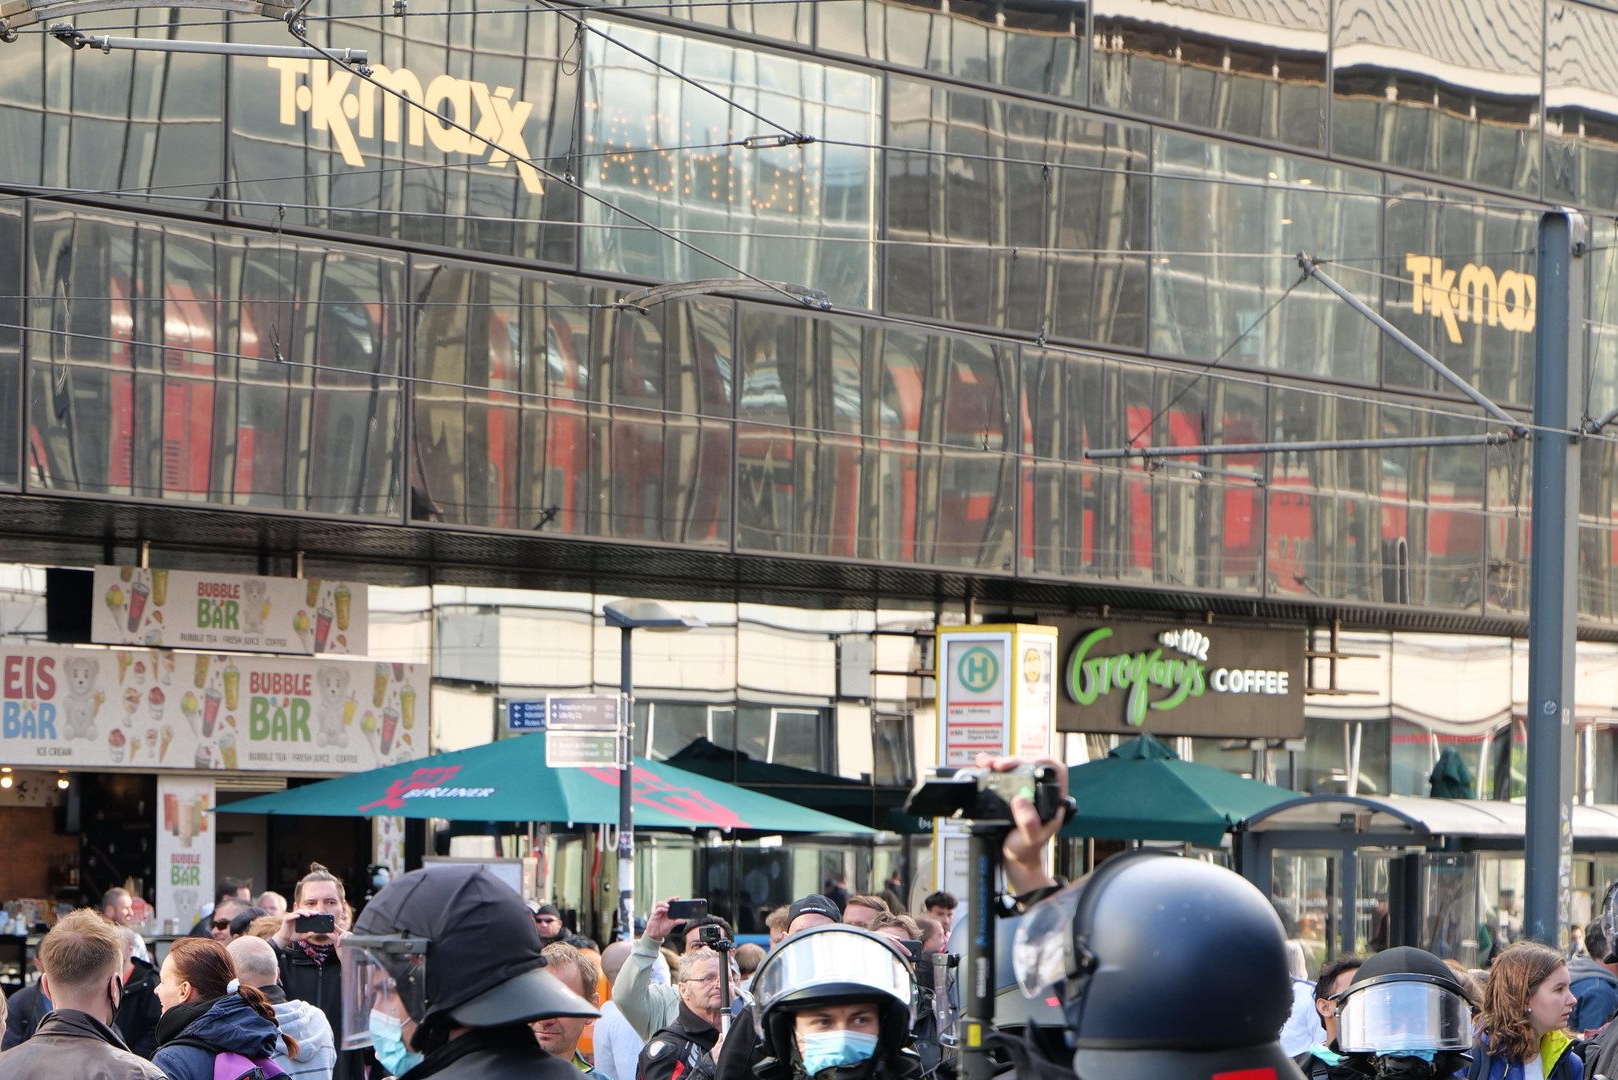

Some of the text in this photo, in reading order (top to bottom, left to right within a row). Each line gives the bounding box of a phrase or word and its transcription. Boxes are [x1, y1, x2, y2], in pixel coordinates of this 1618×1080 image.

[197, 581, 240, 599] BUBBLE
[4, 655, 56, 700] EIS
[250, 671, 312, 696] BUBBLE
[1210, 667, 1289, 694] COFFEE
[36, 747, 47, 756] ICE
[402, 787, 495, 799] BERLINER
